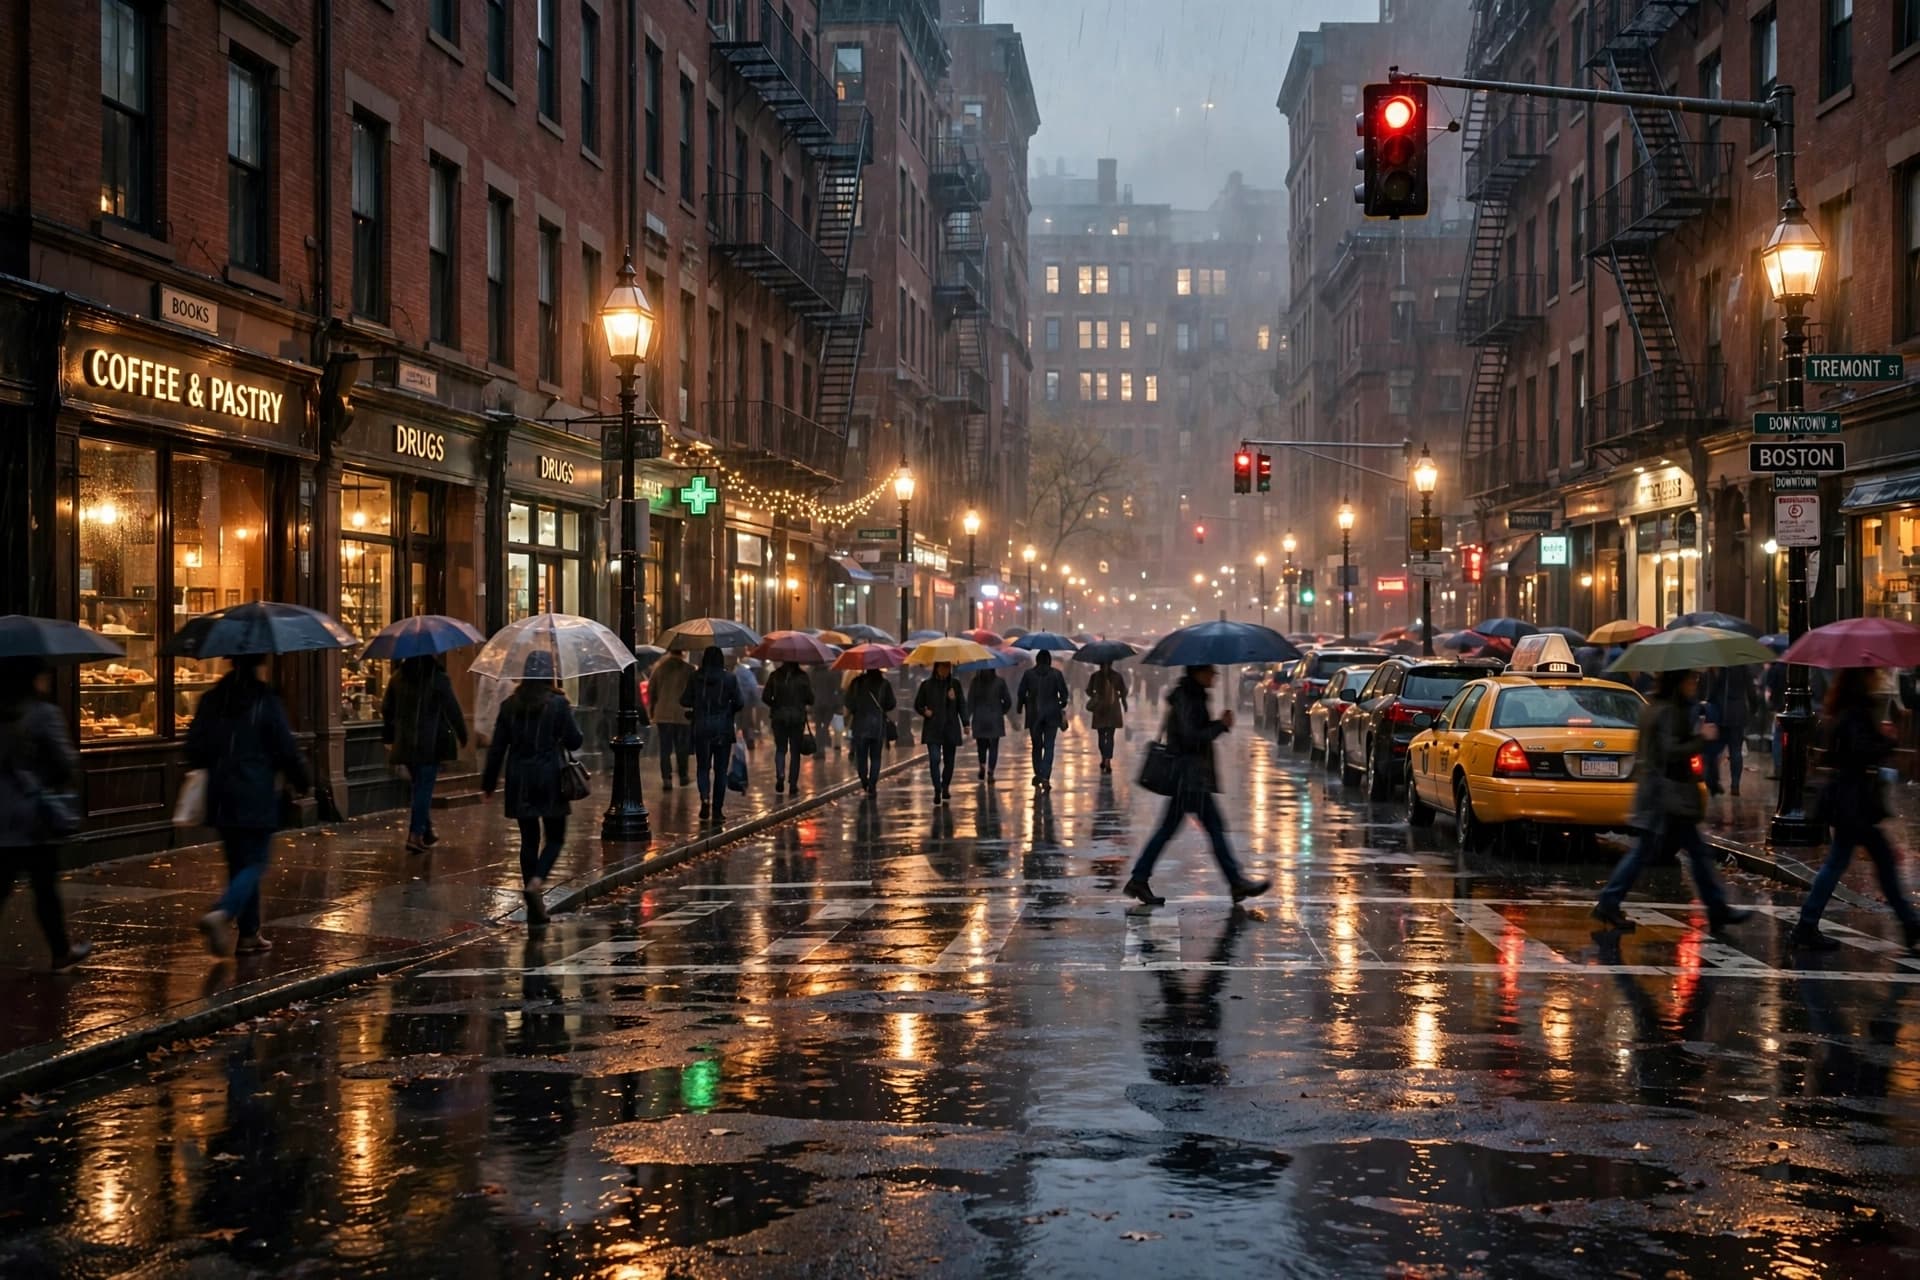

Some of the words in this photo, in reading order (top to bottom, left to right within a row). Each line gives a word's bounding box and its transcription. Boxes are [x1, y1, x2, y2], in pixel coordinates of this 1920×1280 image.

[172, 297, 209, 324] BOOKS
[1812, 359, 1881, 377] TREMONT
[92, 349, 181, 403] COFFEE
[188, 372, 204, 407] &
[211, 378, 283, 424] PASTRY
[396, 425, 445, 462] DRUGS
[1760, 448, 1834, 466] BOSTON
[541, 456, 575, 485] DRUGS
